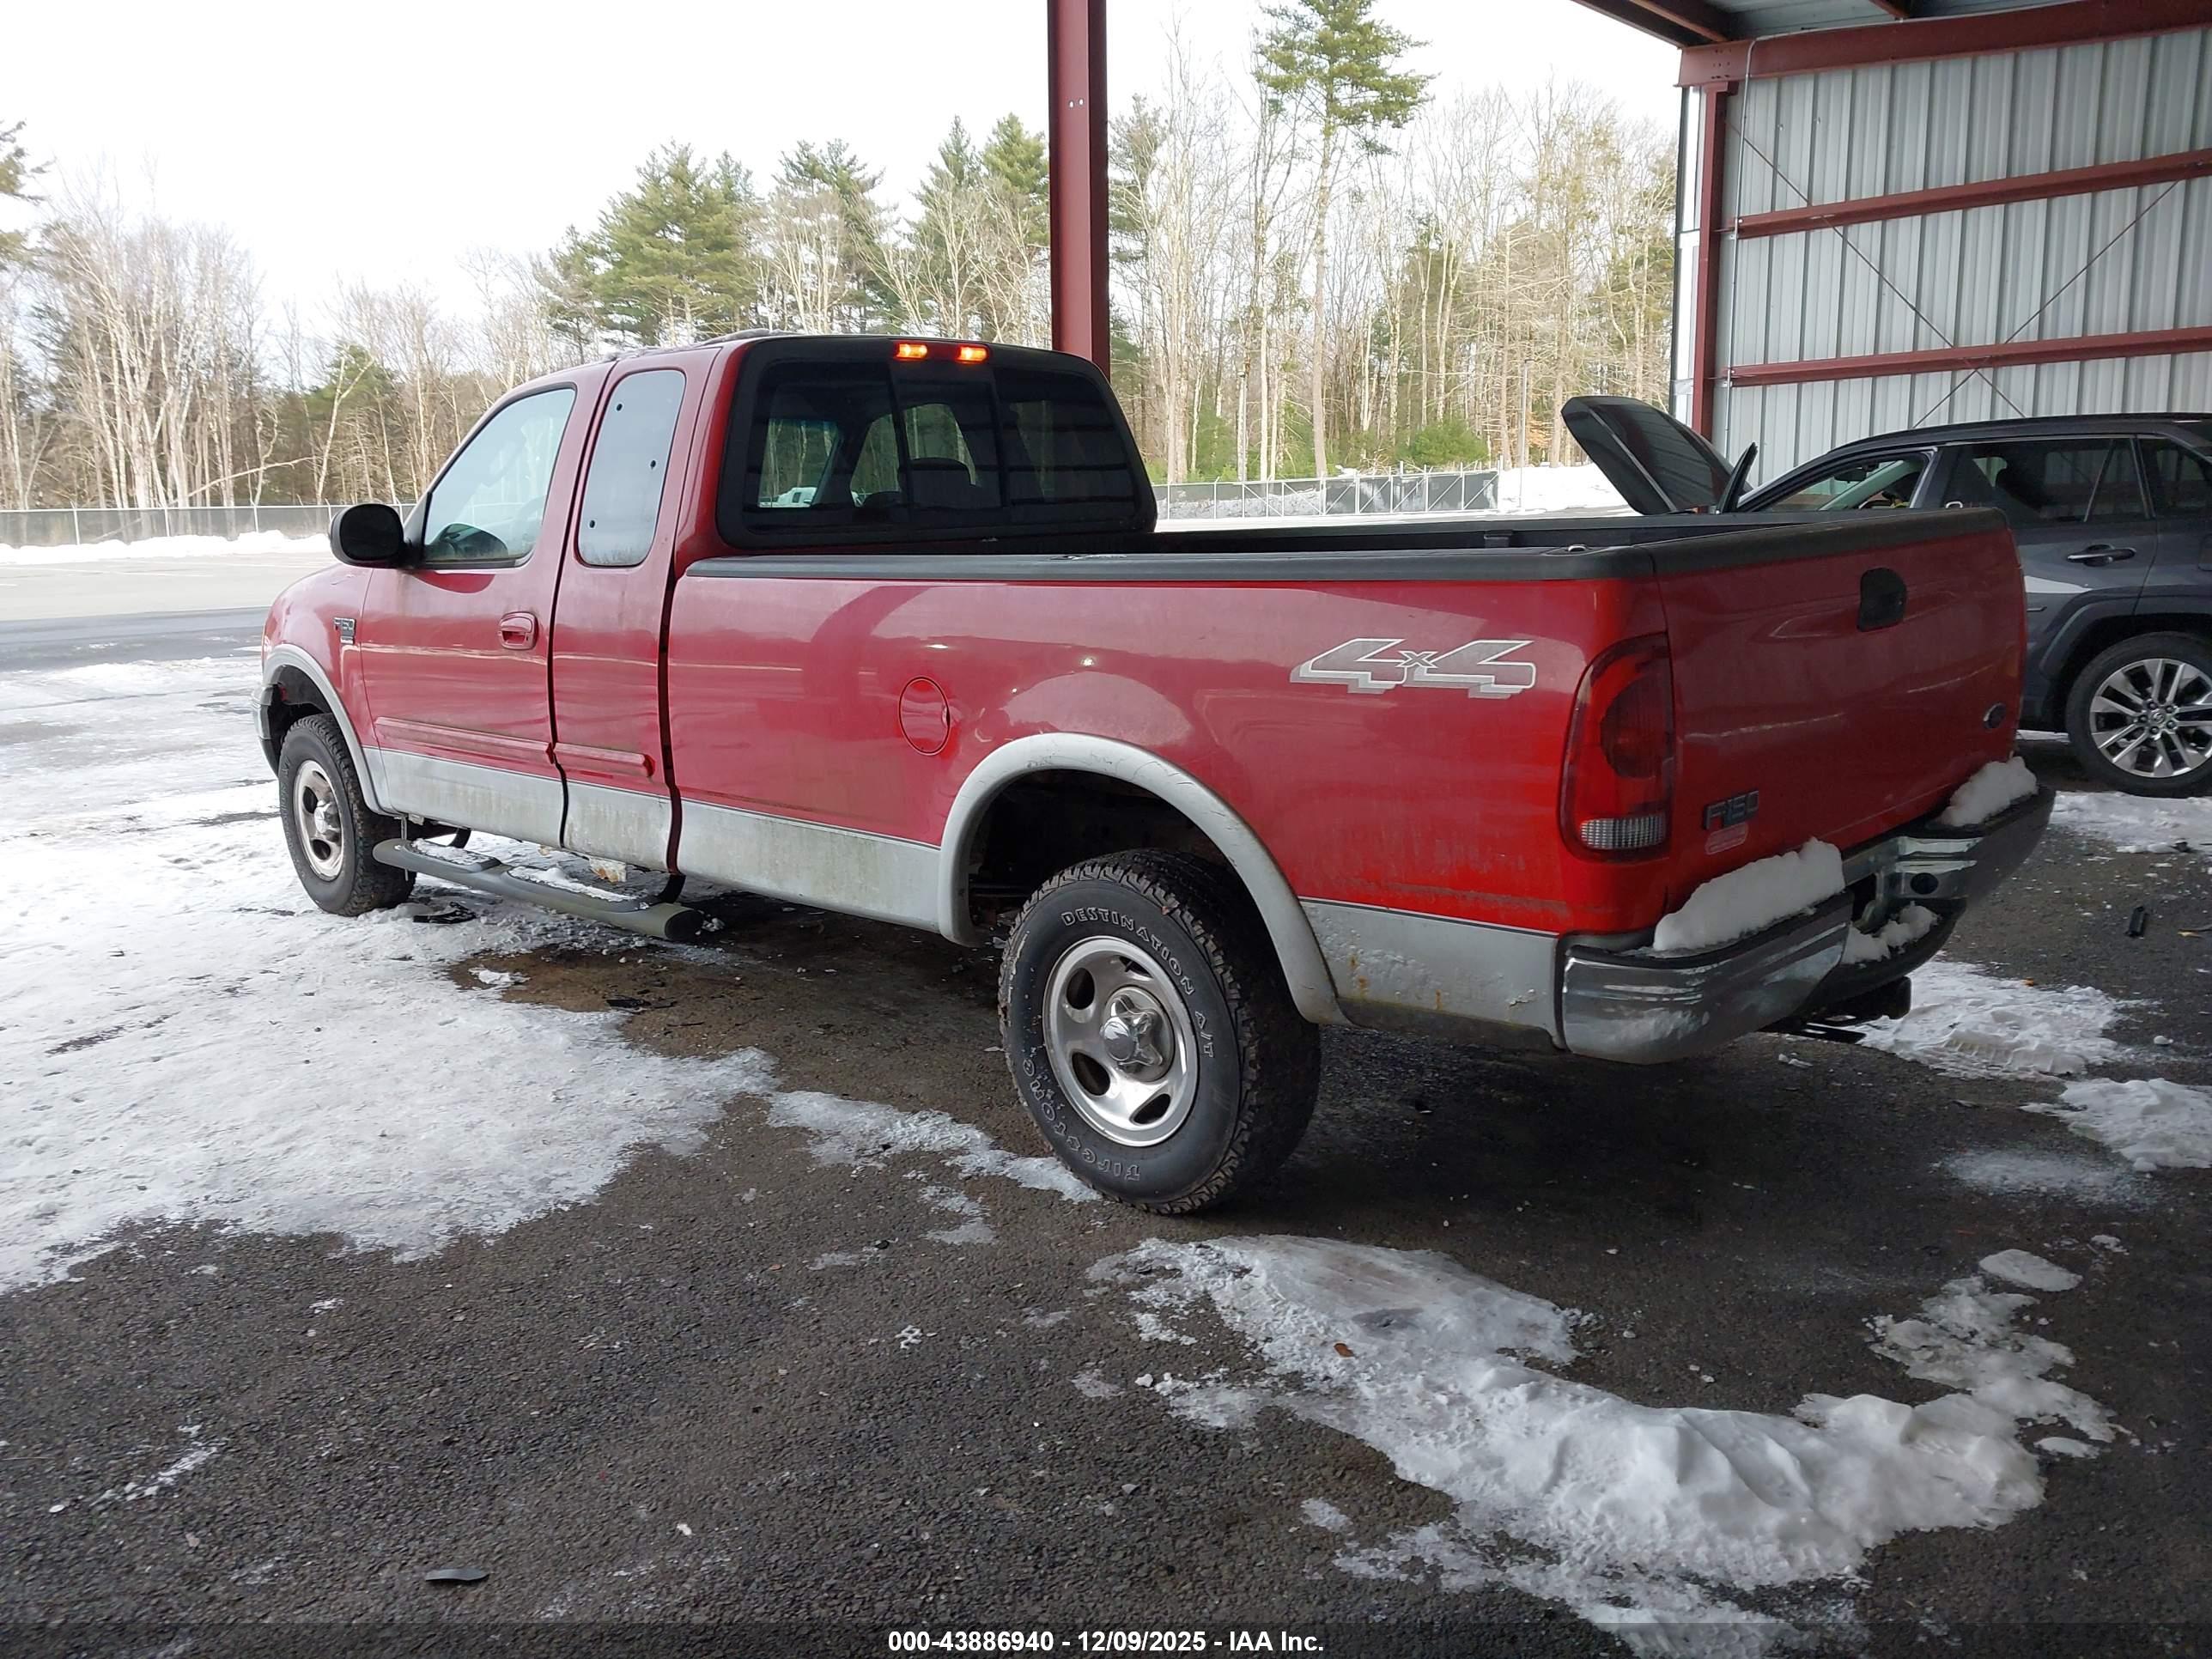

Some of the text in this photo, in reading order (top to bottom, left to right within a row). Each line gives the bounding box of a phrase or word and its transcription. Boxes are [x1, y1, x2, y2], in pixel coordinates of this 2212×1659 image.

[1289, 637, 1537, 700] 4x4
[1061, 906, 1217, 1059] DESTINATION A/T
